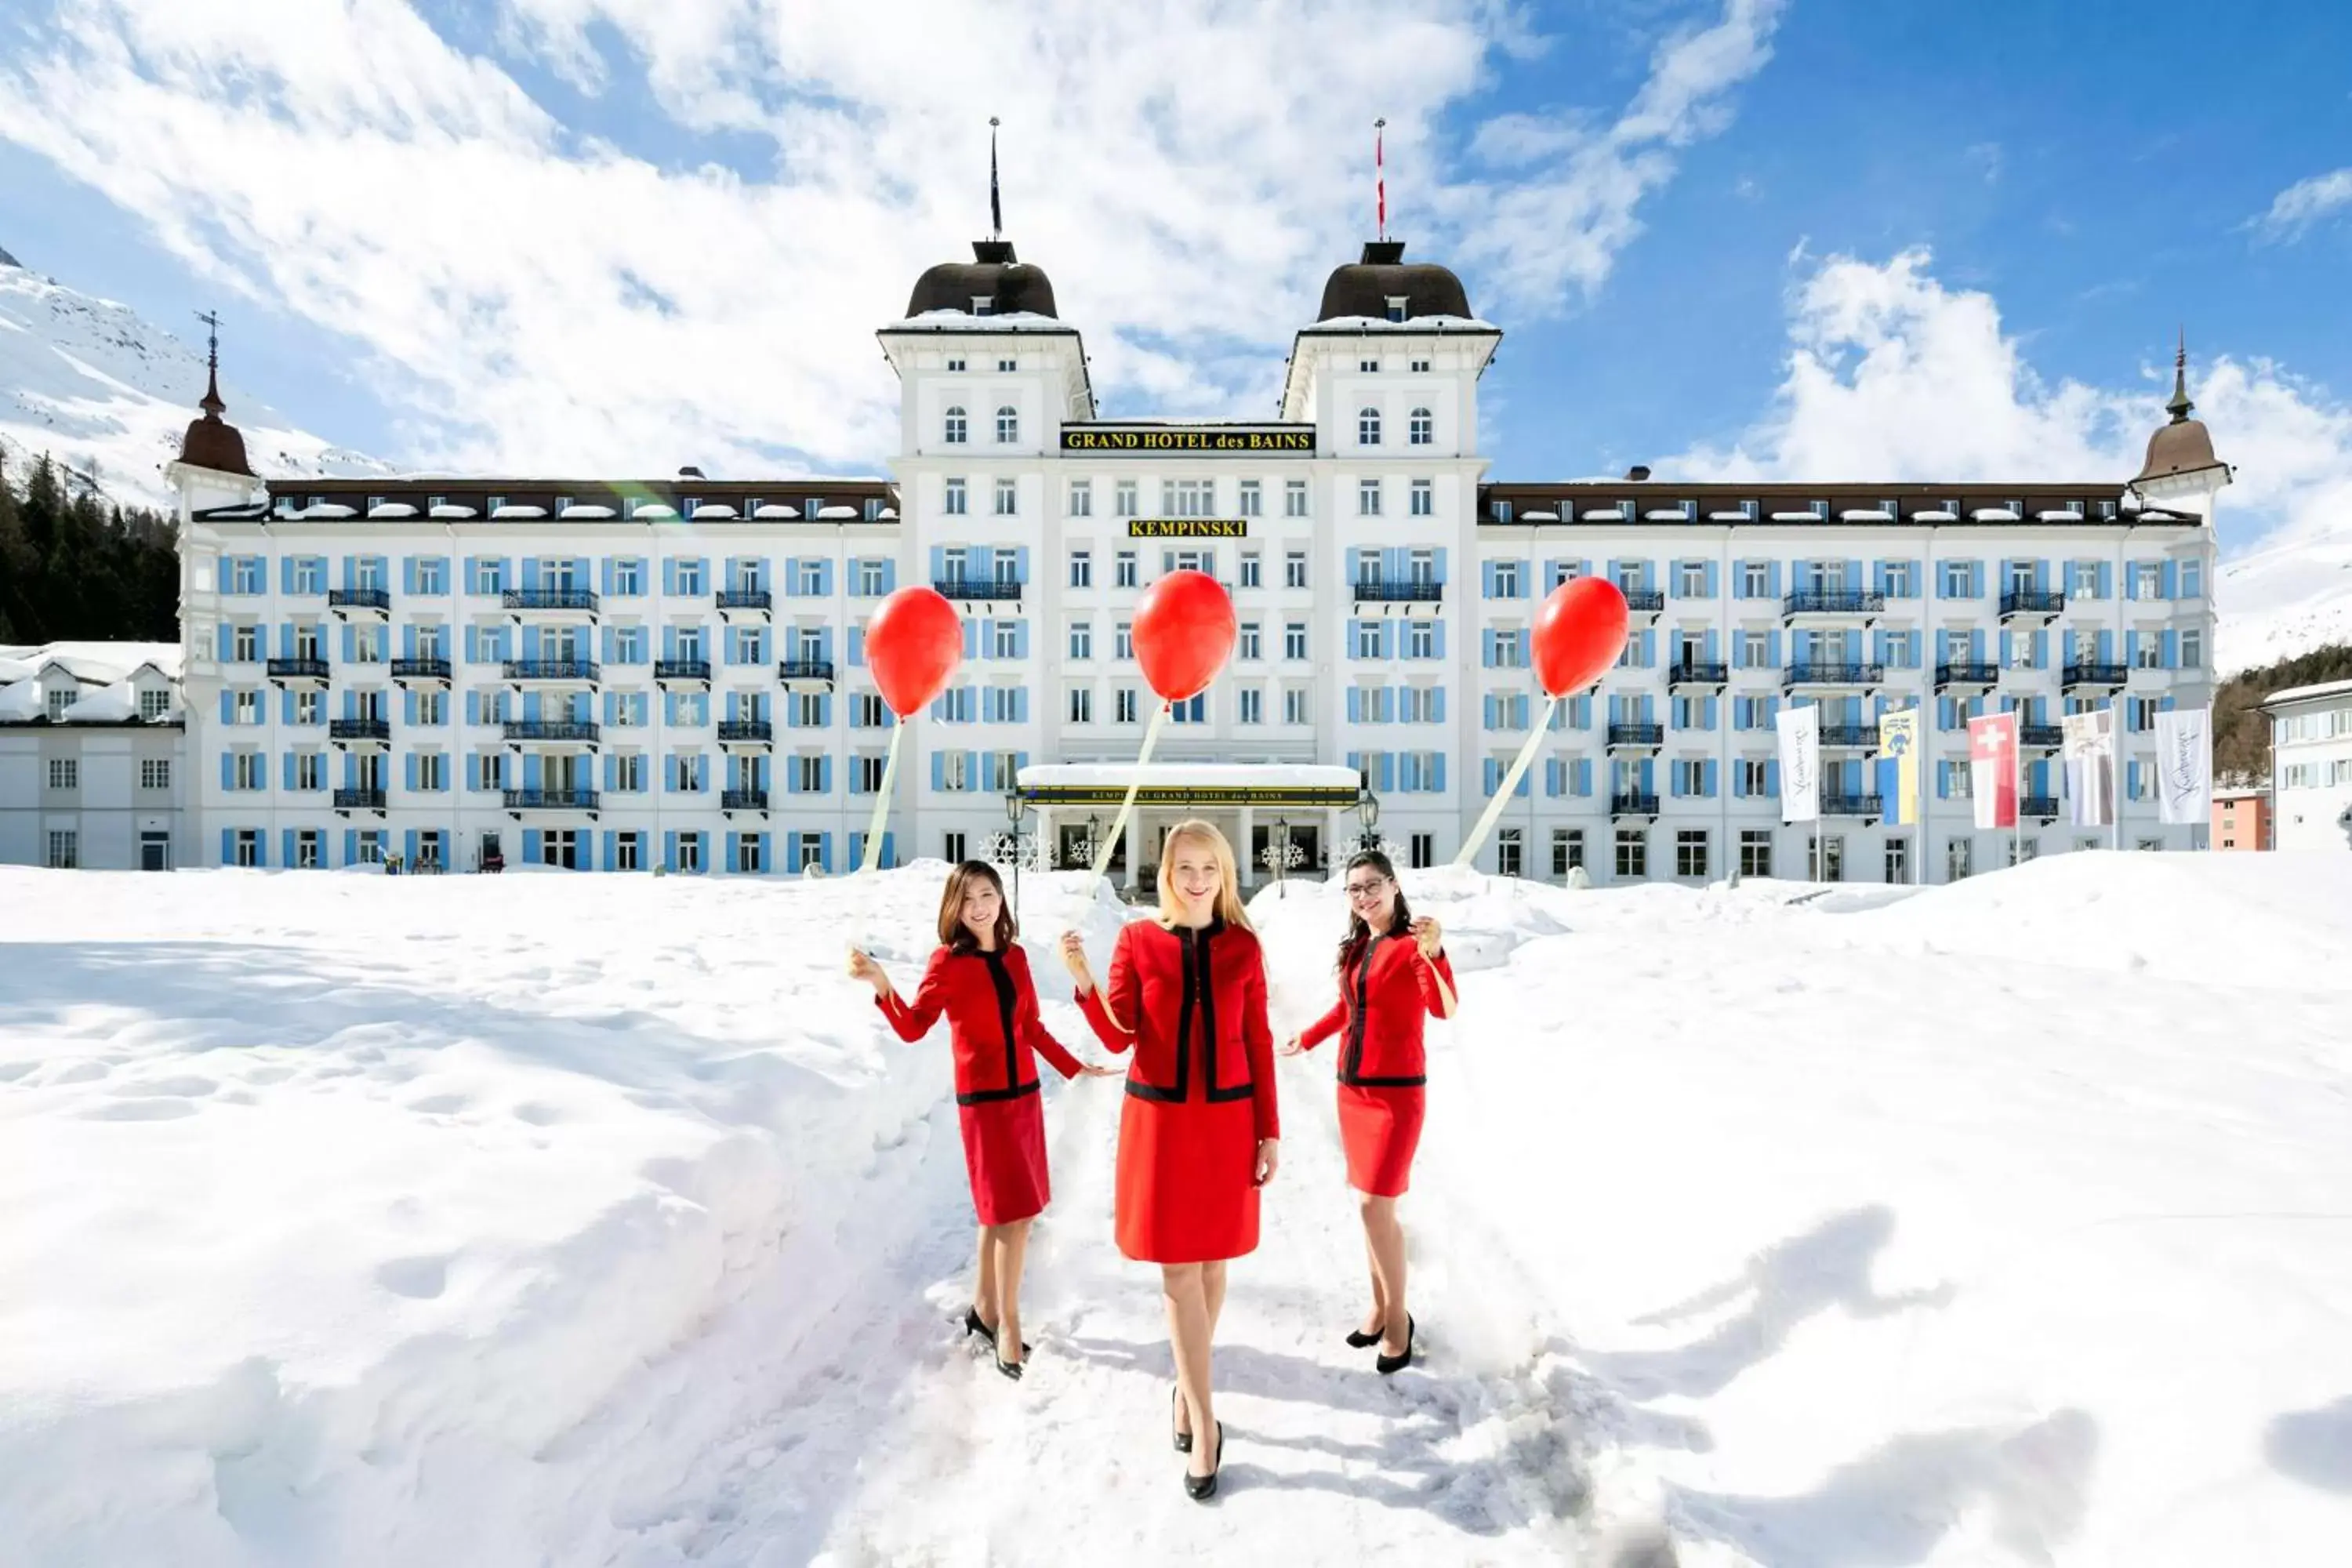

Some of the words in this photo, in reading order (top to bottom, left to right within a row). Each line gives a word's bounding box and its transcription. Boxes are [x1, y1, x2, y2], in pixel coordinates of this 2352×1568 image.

[1067, 434, 1138, 448] GRAND
[1217, 434, 1244, 448] des
[1250, 434, 1309, 448] BAINS
[1130, 521, 1243, 535] KEMPINSKI
